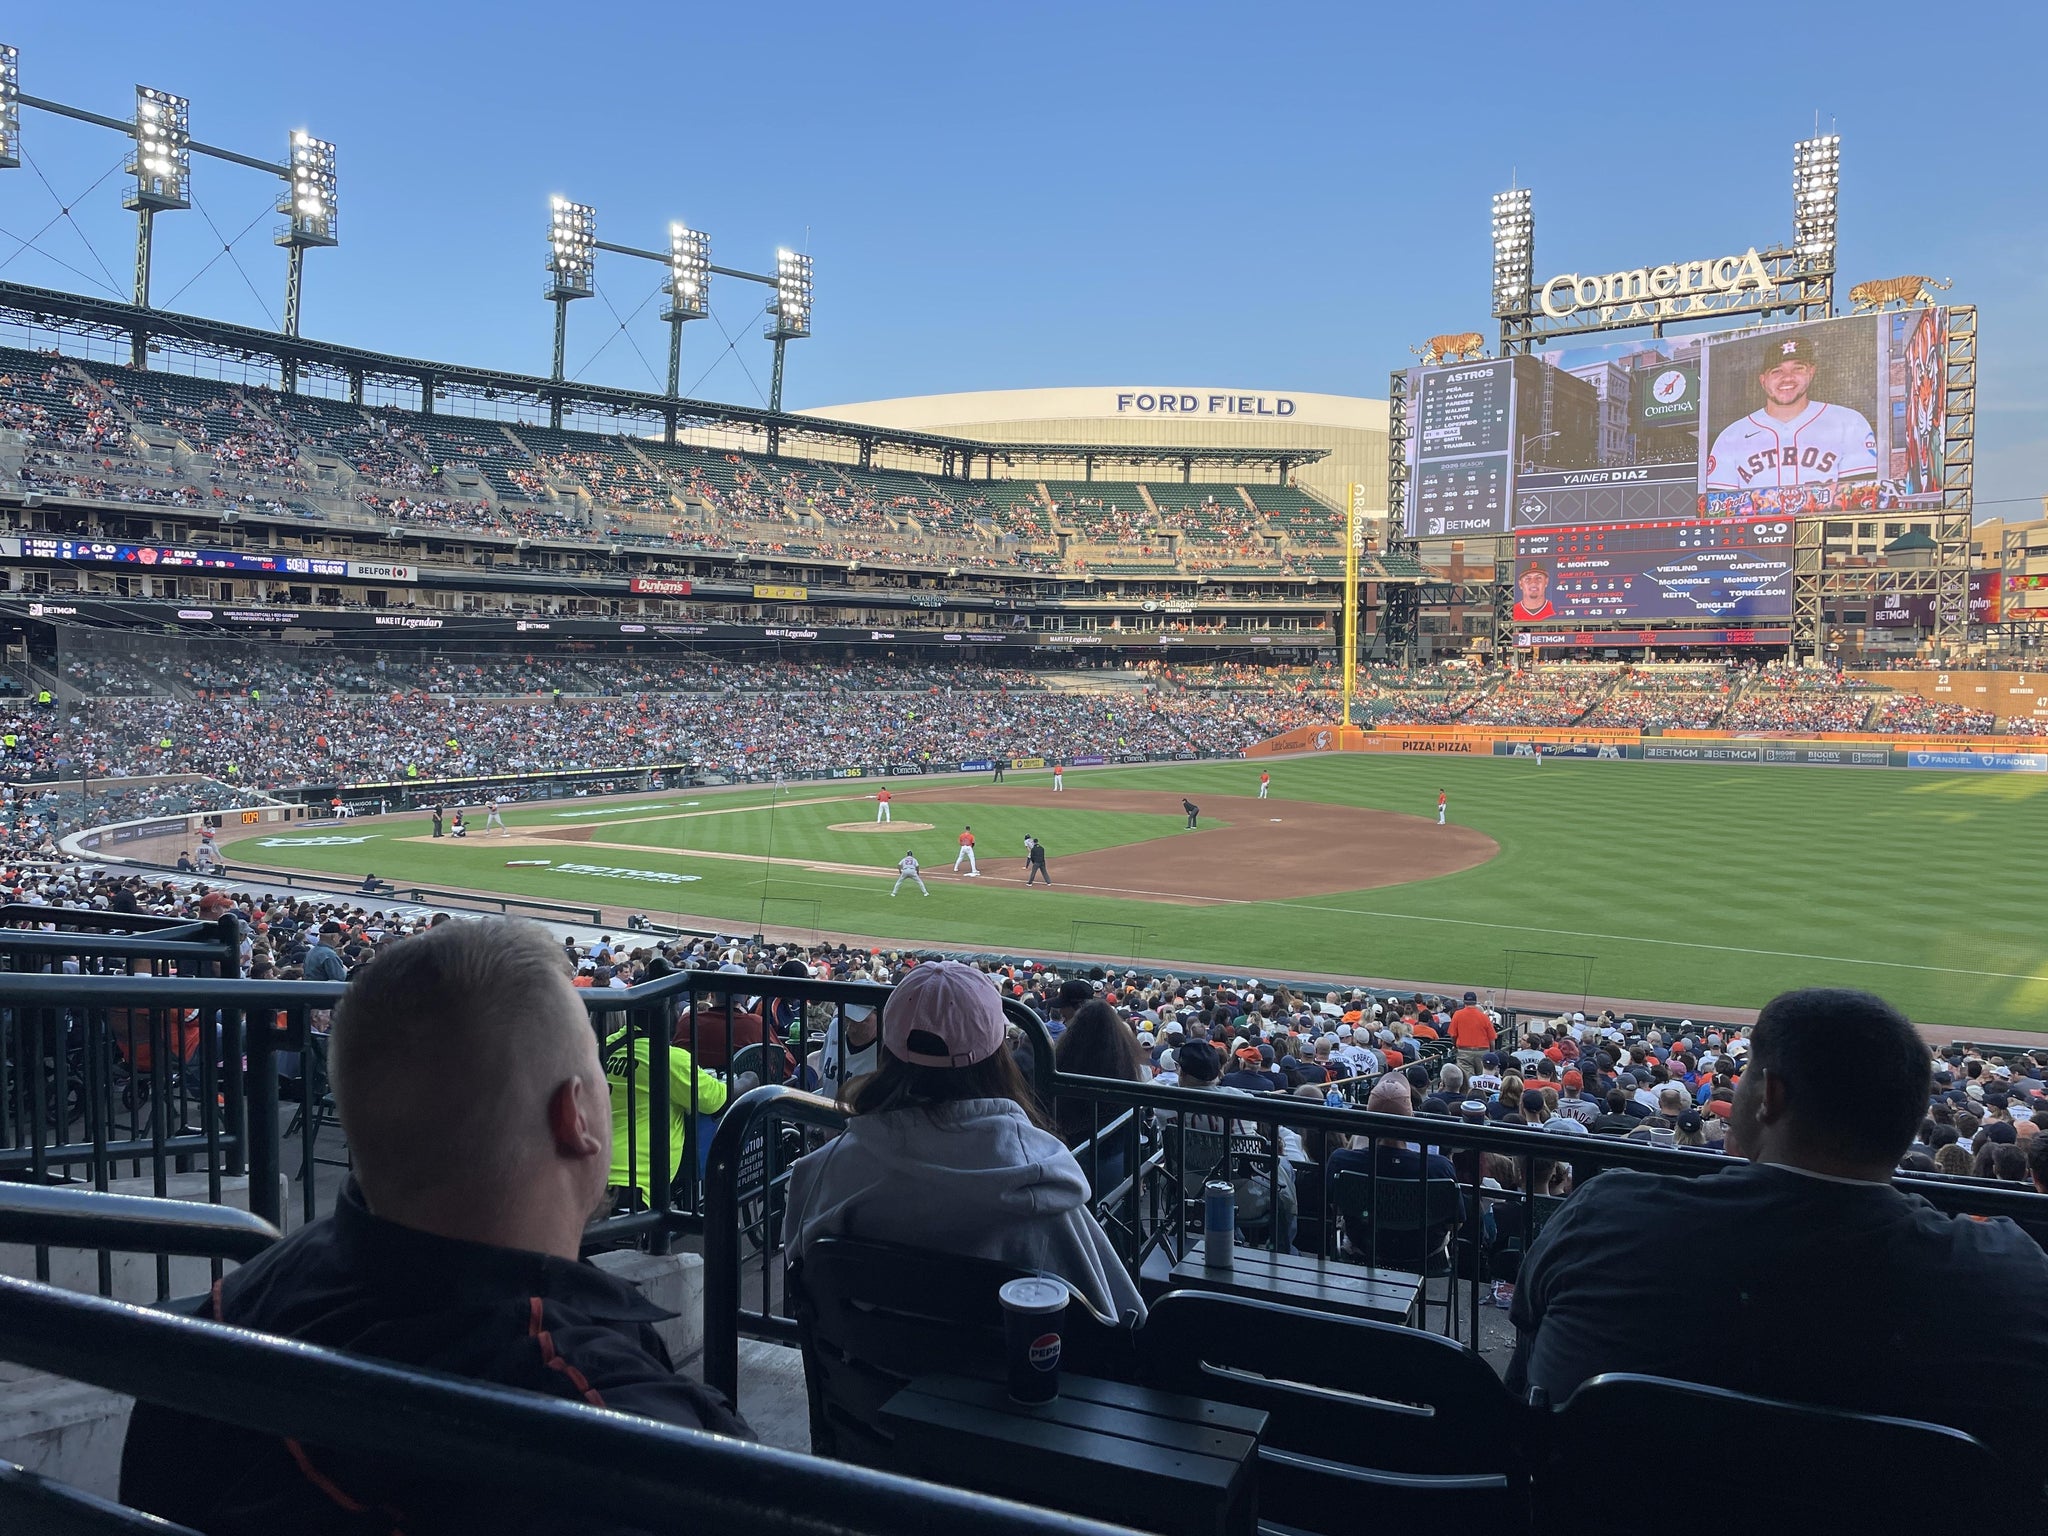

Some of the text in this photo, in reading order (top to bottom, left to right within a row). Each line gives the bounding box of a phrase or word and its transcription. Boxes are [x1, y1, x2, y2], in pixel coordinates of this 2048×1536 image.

[1601, 294, 1709, 322] PARK
[1447, 369, 1494, 383] ASTROS
[1446, 392, 1474, 400] ALVAREZ
[1117, 393, 1296, 416] FORD FIELD
[1738, 446, 1836, 484] ASTROS
[1563, 470, 1648, 484] YAINER DIAZ
[1712, 492, 1748, 514] Detroit
[1447, 519, 1490, 529] BETMGM
[1754, 524, 1787, 534] 0-0
[33, 540, 57, 548] HOU
[92, 544, 116, 553] 0-0
[359, 566, 390, 575] BELFOR
[639, 580, 683, 592] Dunham's
[1160, 600, 1198, 610] Gallagher
[1876, 610, 1909, 620] BETMGM
[401, 617, 443, 628] Legendary
[785, 629, 817, 638] Legendary
[1939, 675, 1948, 684] 23
[2019, 676, 2024, 685] 5
[2037, 697, 2047, 706] 47
[1403, 742, 1472, 752] PIZZA! PIZZA!
[1656, 749, 1698, 757] BETMGM
[1713, 750, 1756, 759] BETMGM
[833, 768, 861, 777] bet365
[1473, 1081, 1500, 1090] BROWN
[1032, 1345, 1059, 1358] PEPSI
